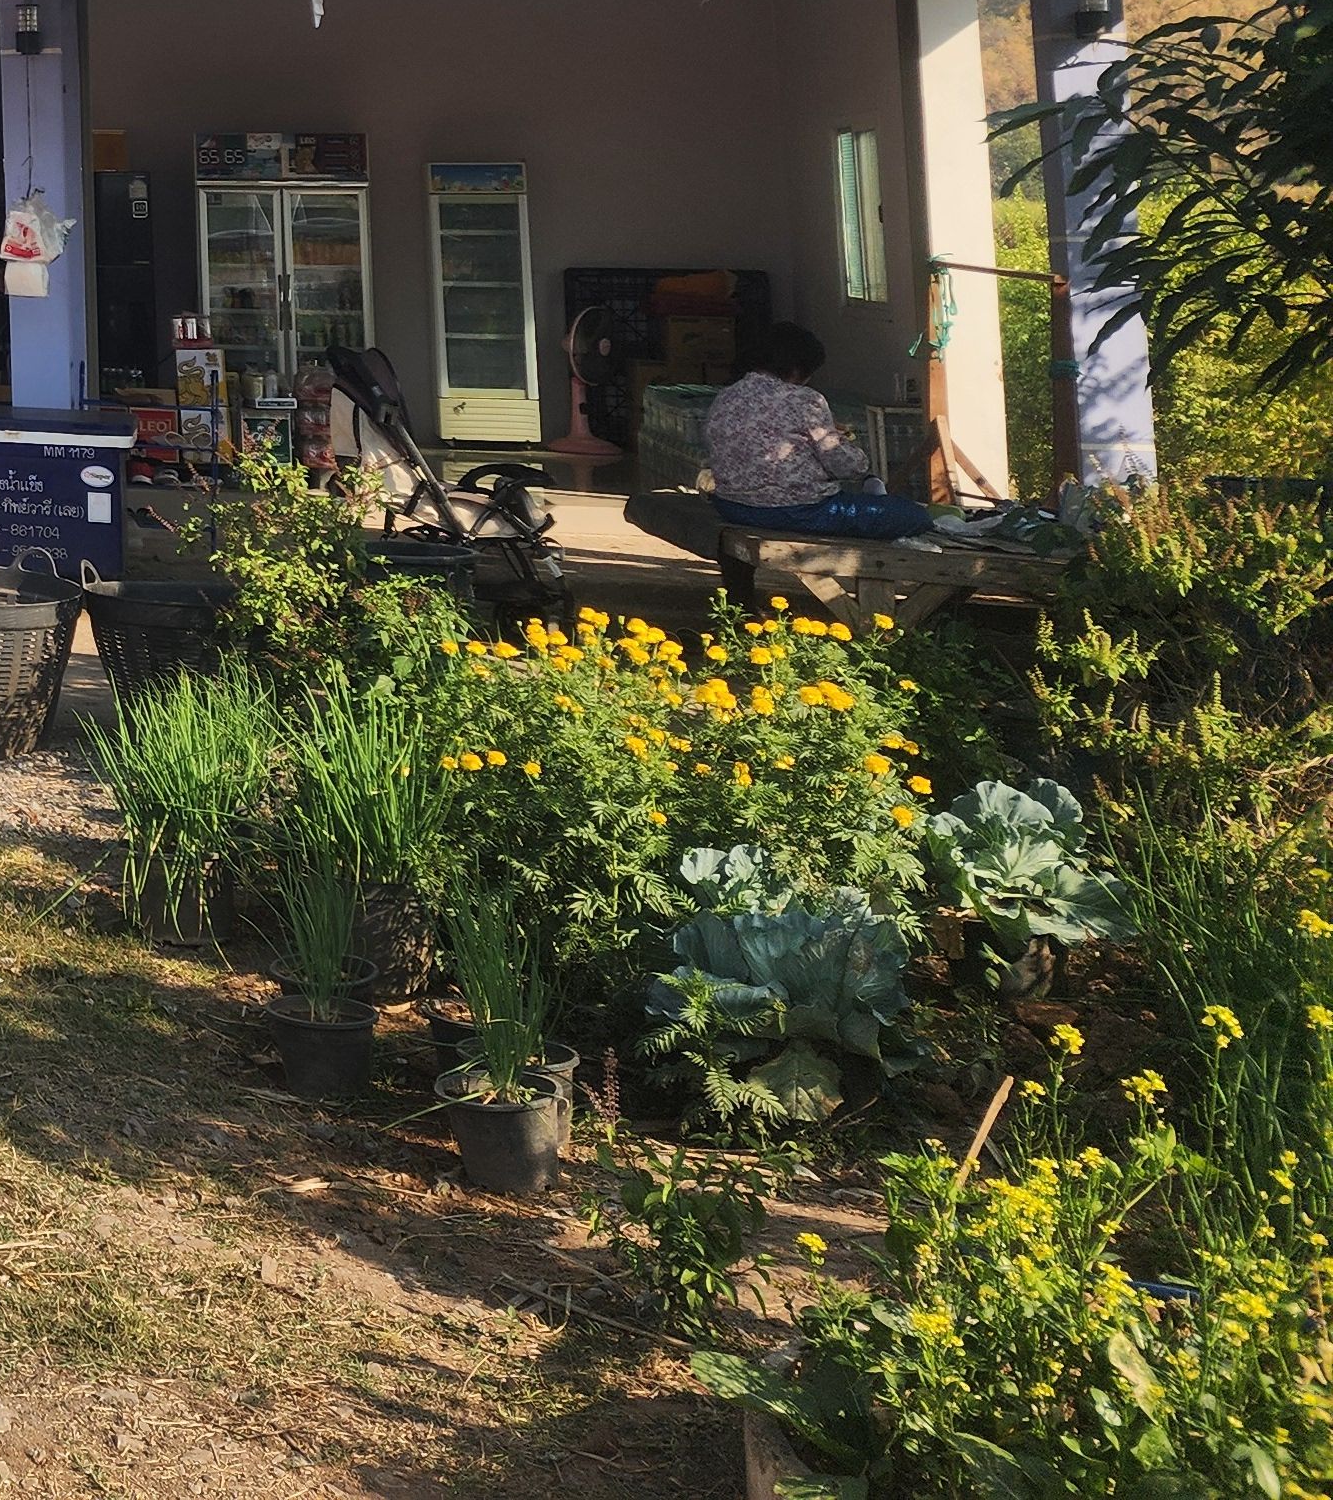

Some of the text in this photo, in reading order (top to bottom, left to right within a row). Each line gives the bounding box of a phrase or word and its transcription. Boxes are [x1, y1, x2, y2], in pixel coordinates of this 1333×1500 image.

[139, 420, 167, 432] LEO
[43, 446, 95, 459] MM 1179
